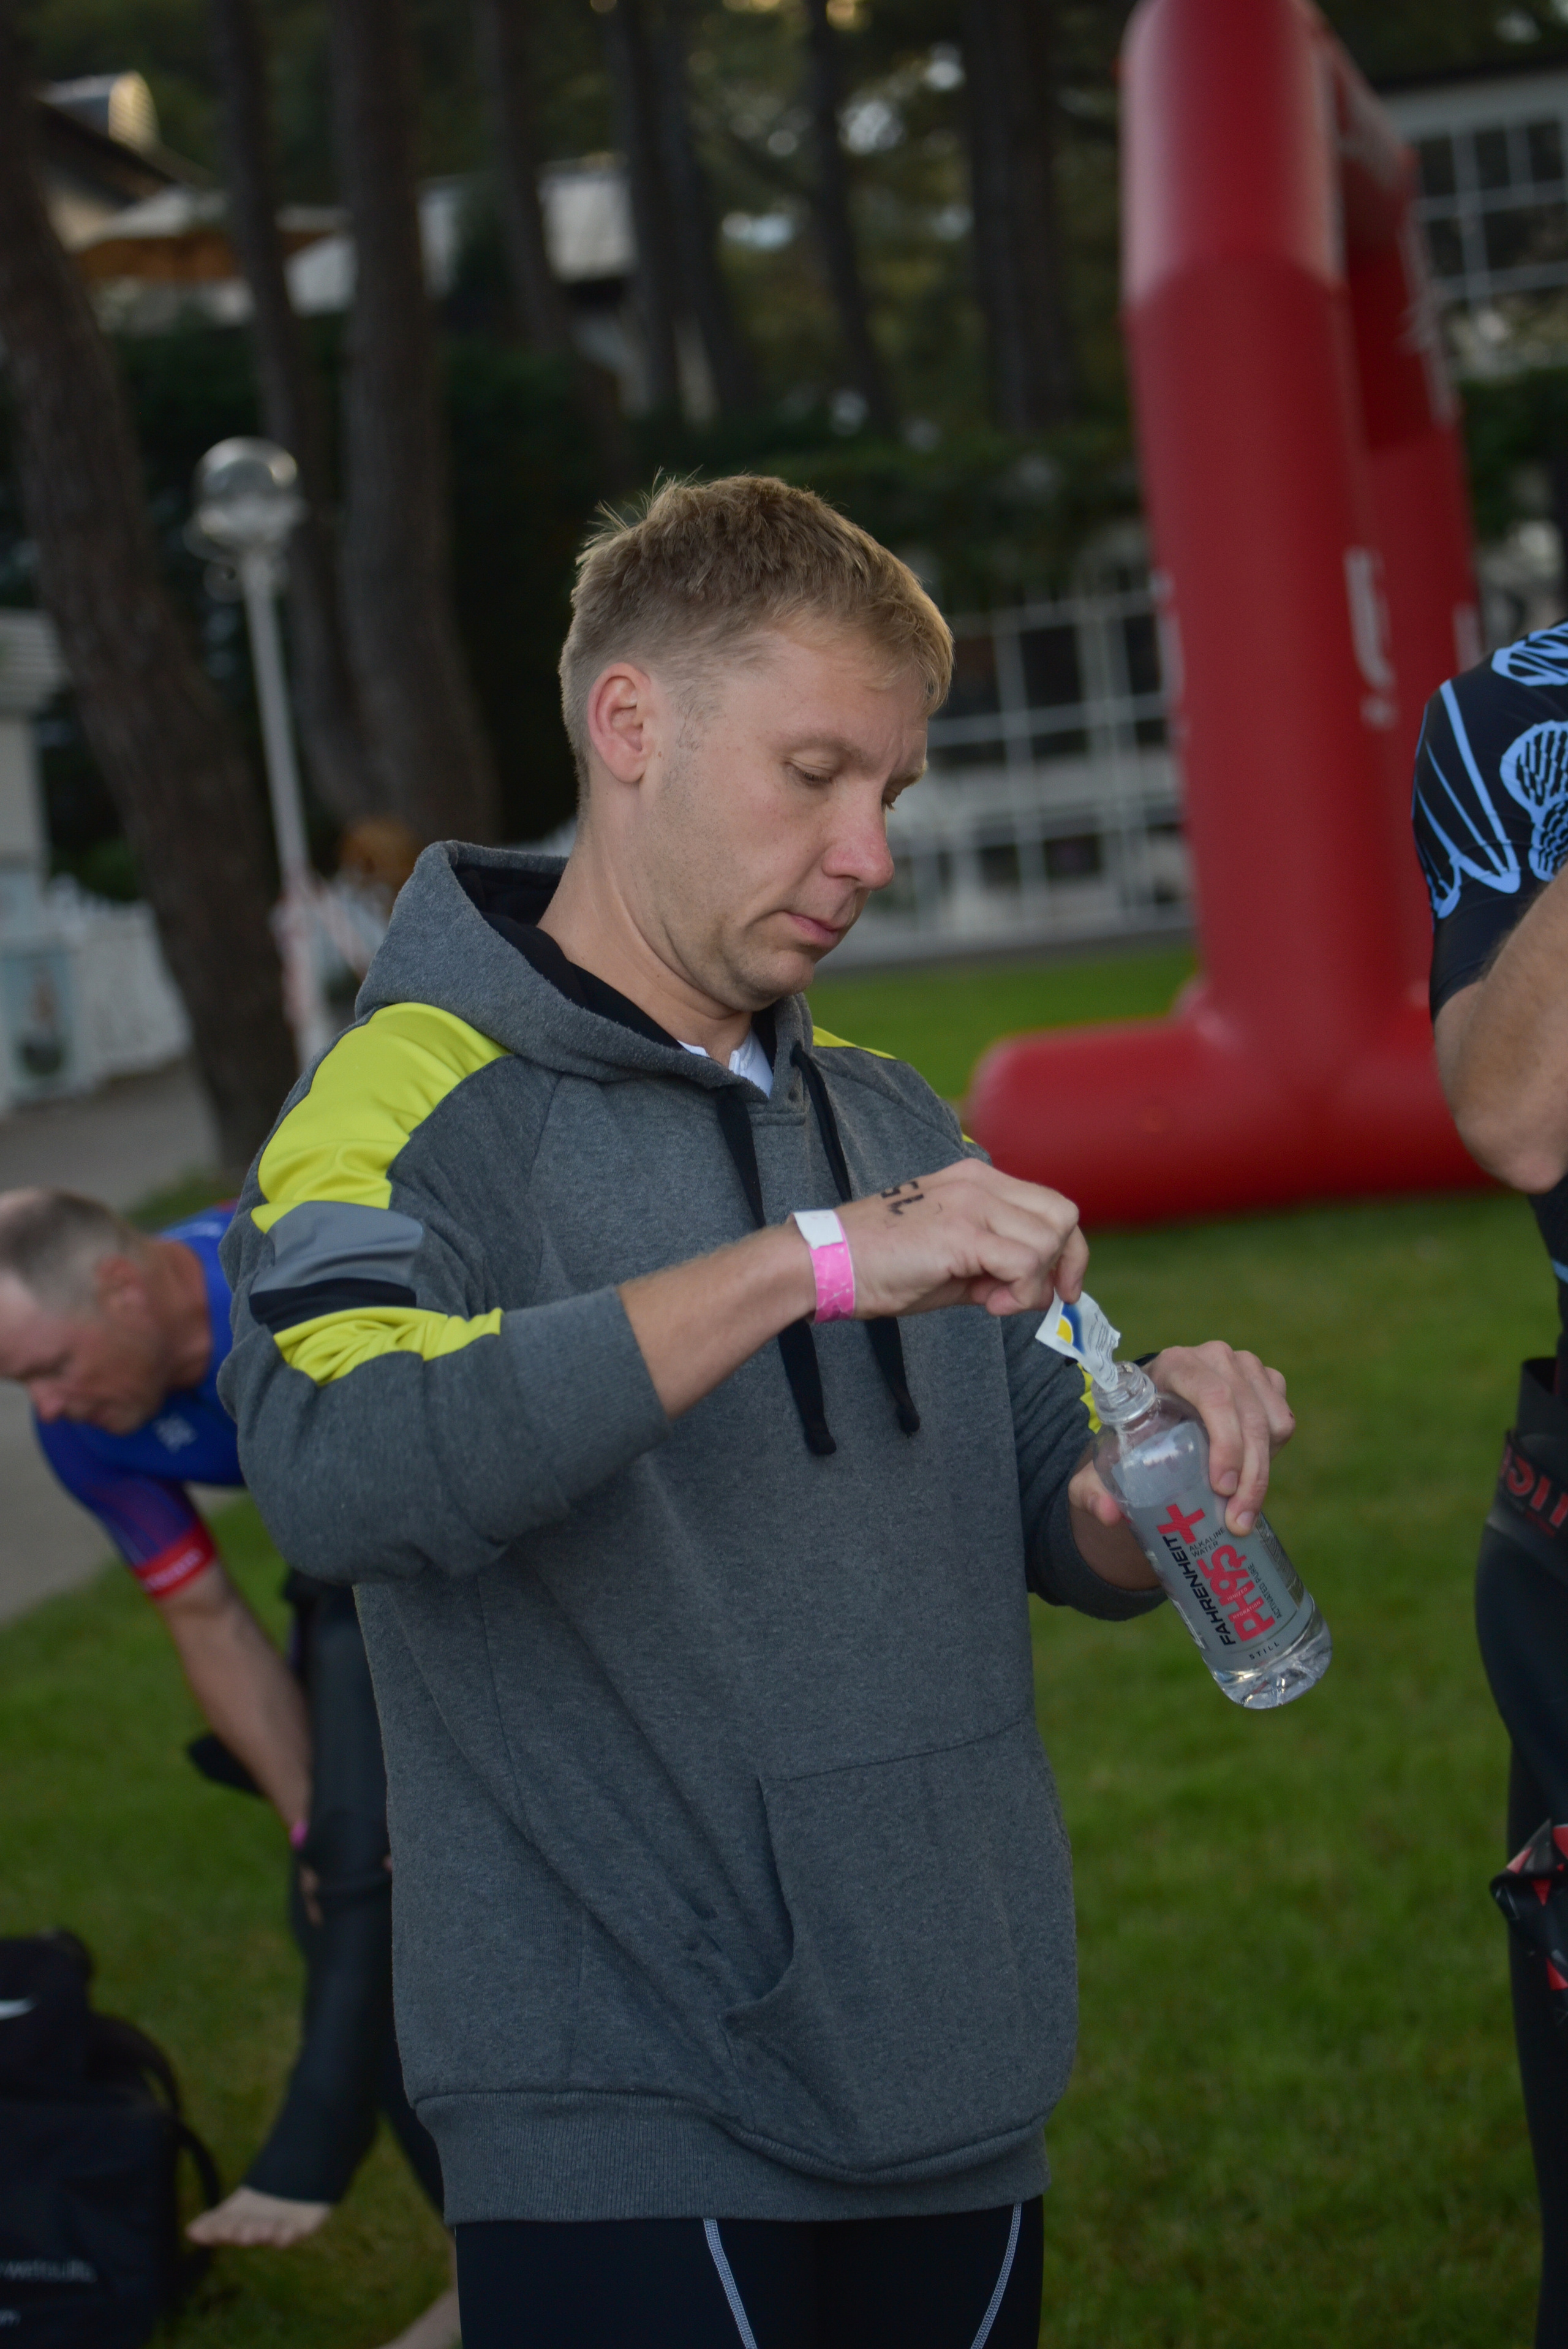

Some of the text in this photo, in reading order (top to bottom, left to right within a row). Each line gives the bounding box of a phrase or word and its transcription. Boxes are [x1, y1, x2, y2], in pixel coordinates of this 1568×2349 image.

[1189, 1527, 1226, 1551] ALKALINE
[1191, 1541, 1219, 1557] WATER
[1163, 1536, 1236, 1646] FAHRENHEIT
[1227, 1587, 1248, 1601] IONIZED
[1248, 1562, 1281, 1619] ACTIVATED PURE
[1232, 1601, 1261, 1619] HYDRATION
[1249, 1642, 1280, 1660] STILL
